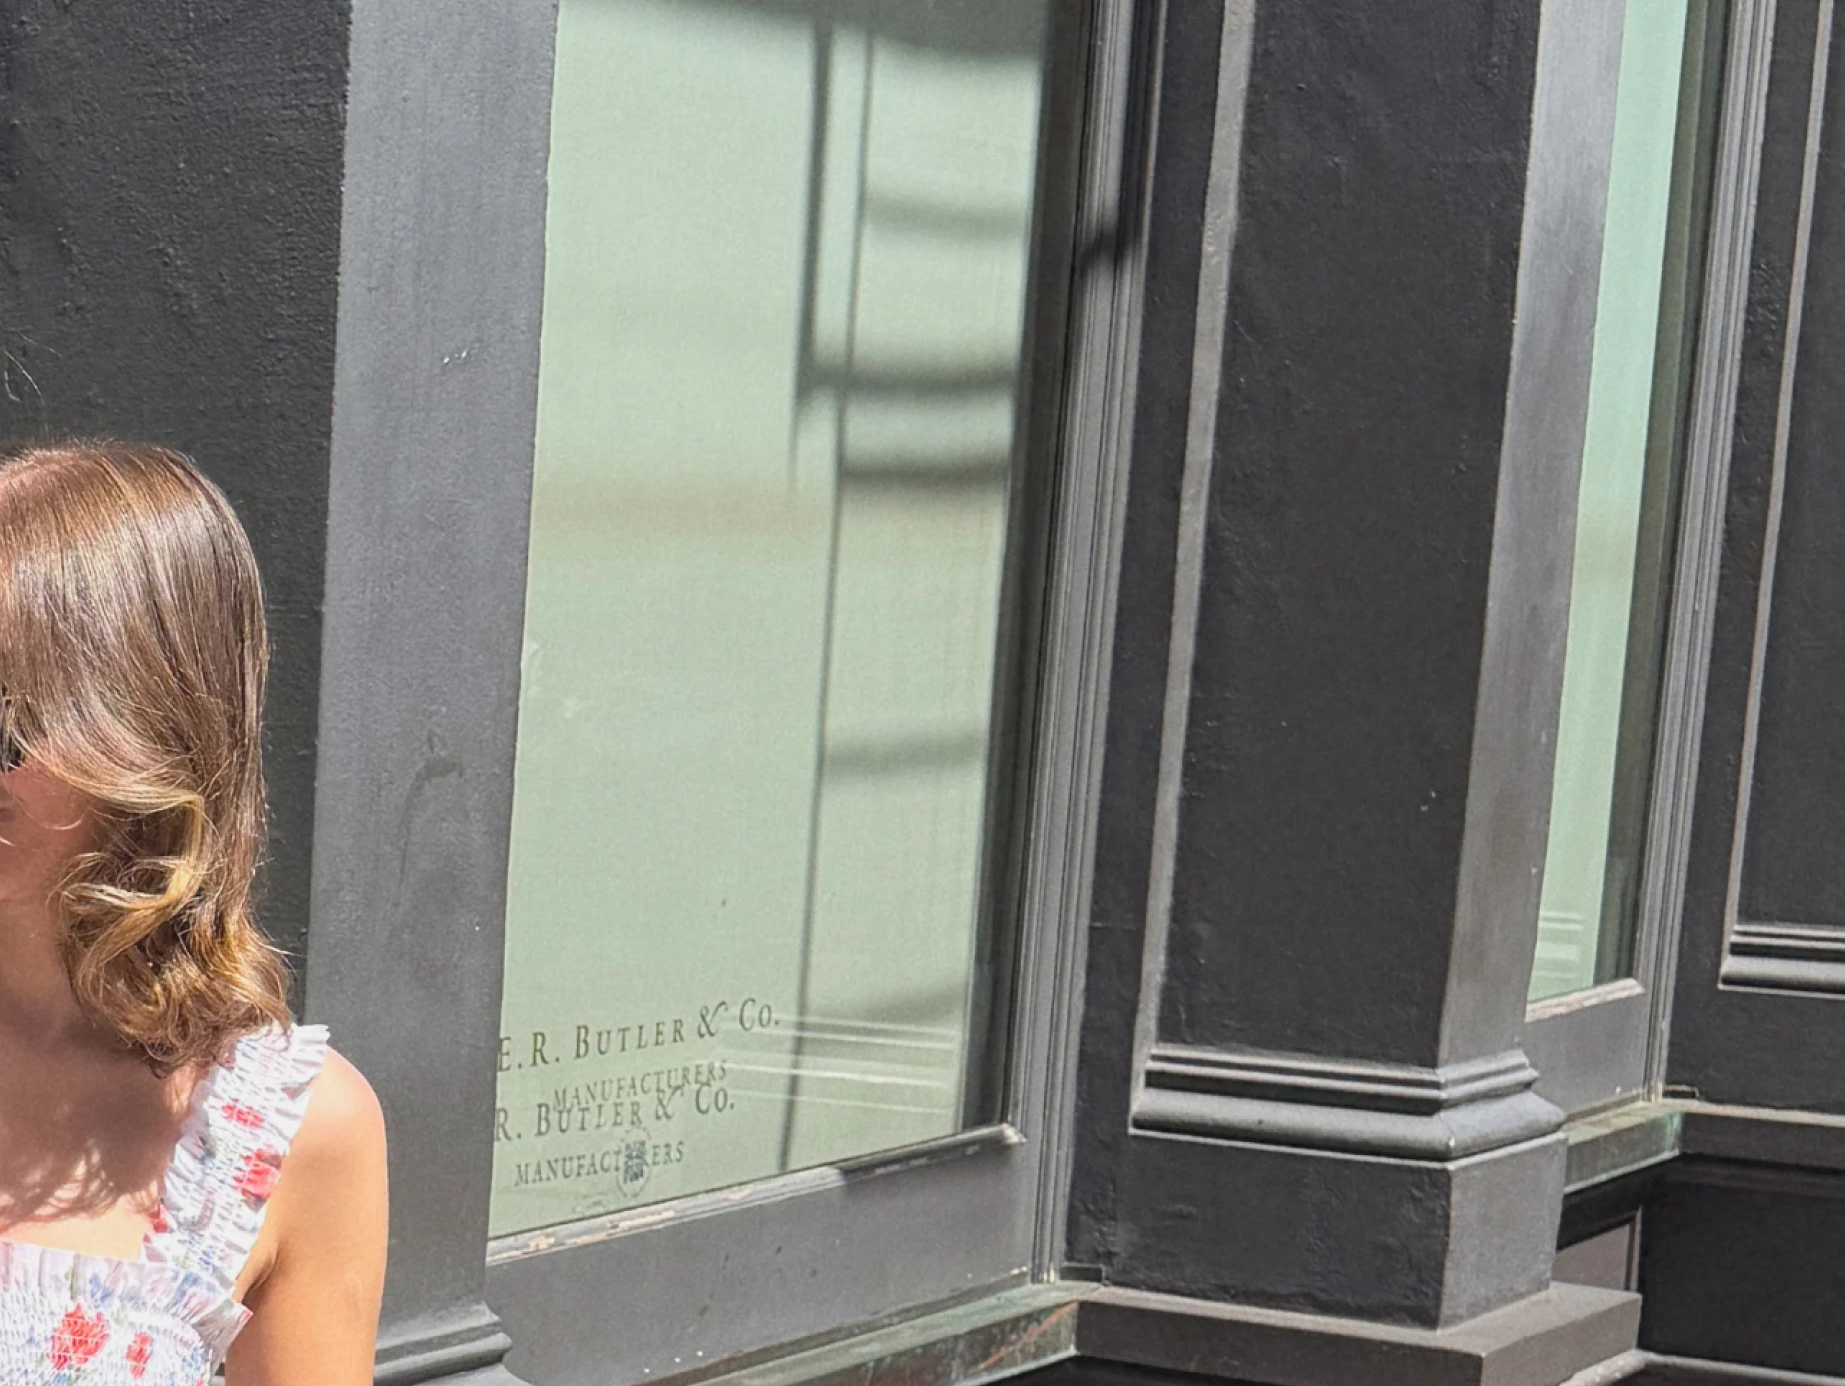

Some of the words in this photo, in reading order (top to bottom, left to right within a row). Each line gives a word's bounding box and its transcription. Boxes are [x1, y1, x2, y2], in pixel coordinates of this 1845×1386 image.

[574, 1019, 685, 1060] BUTLER
[697, 1001, 728, 1039] &
[554, 1059, 728, 1110] MANUFACTURERS
[536, 1101, 643, 1138] BUTLER
[515, 1141, 686, 1188] MANUFACTERS
